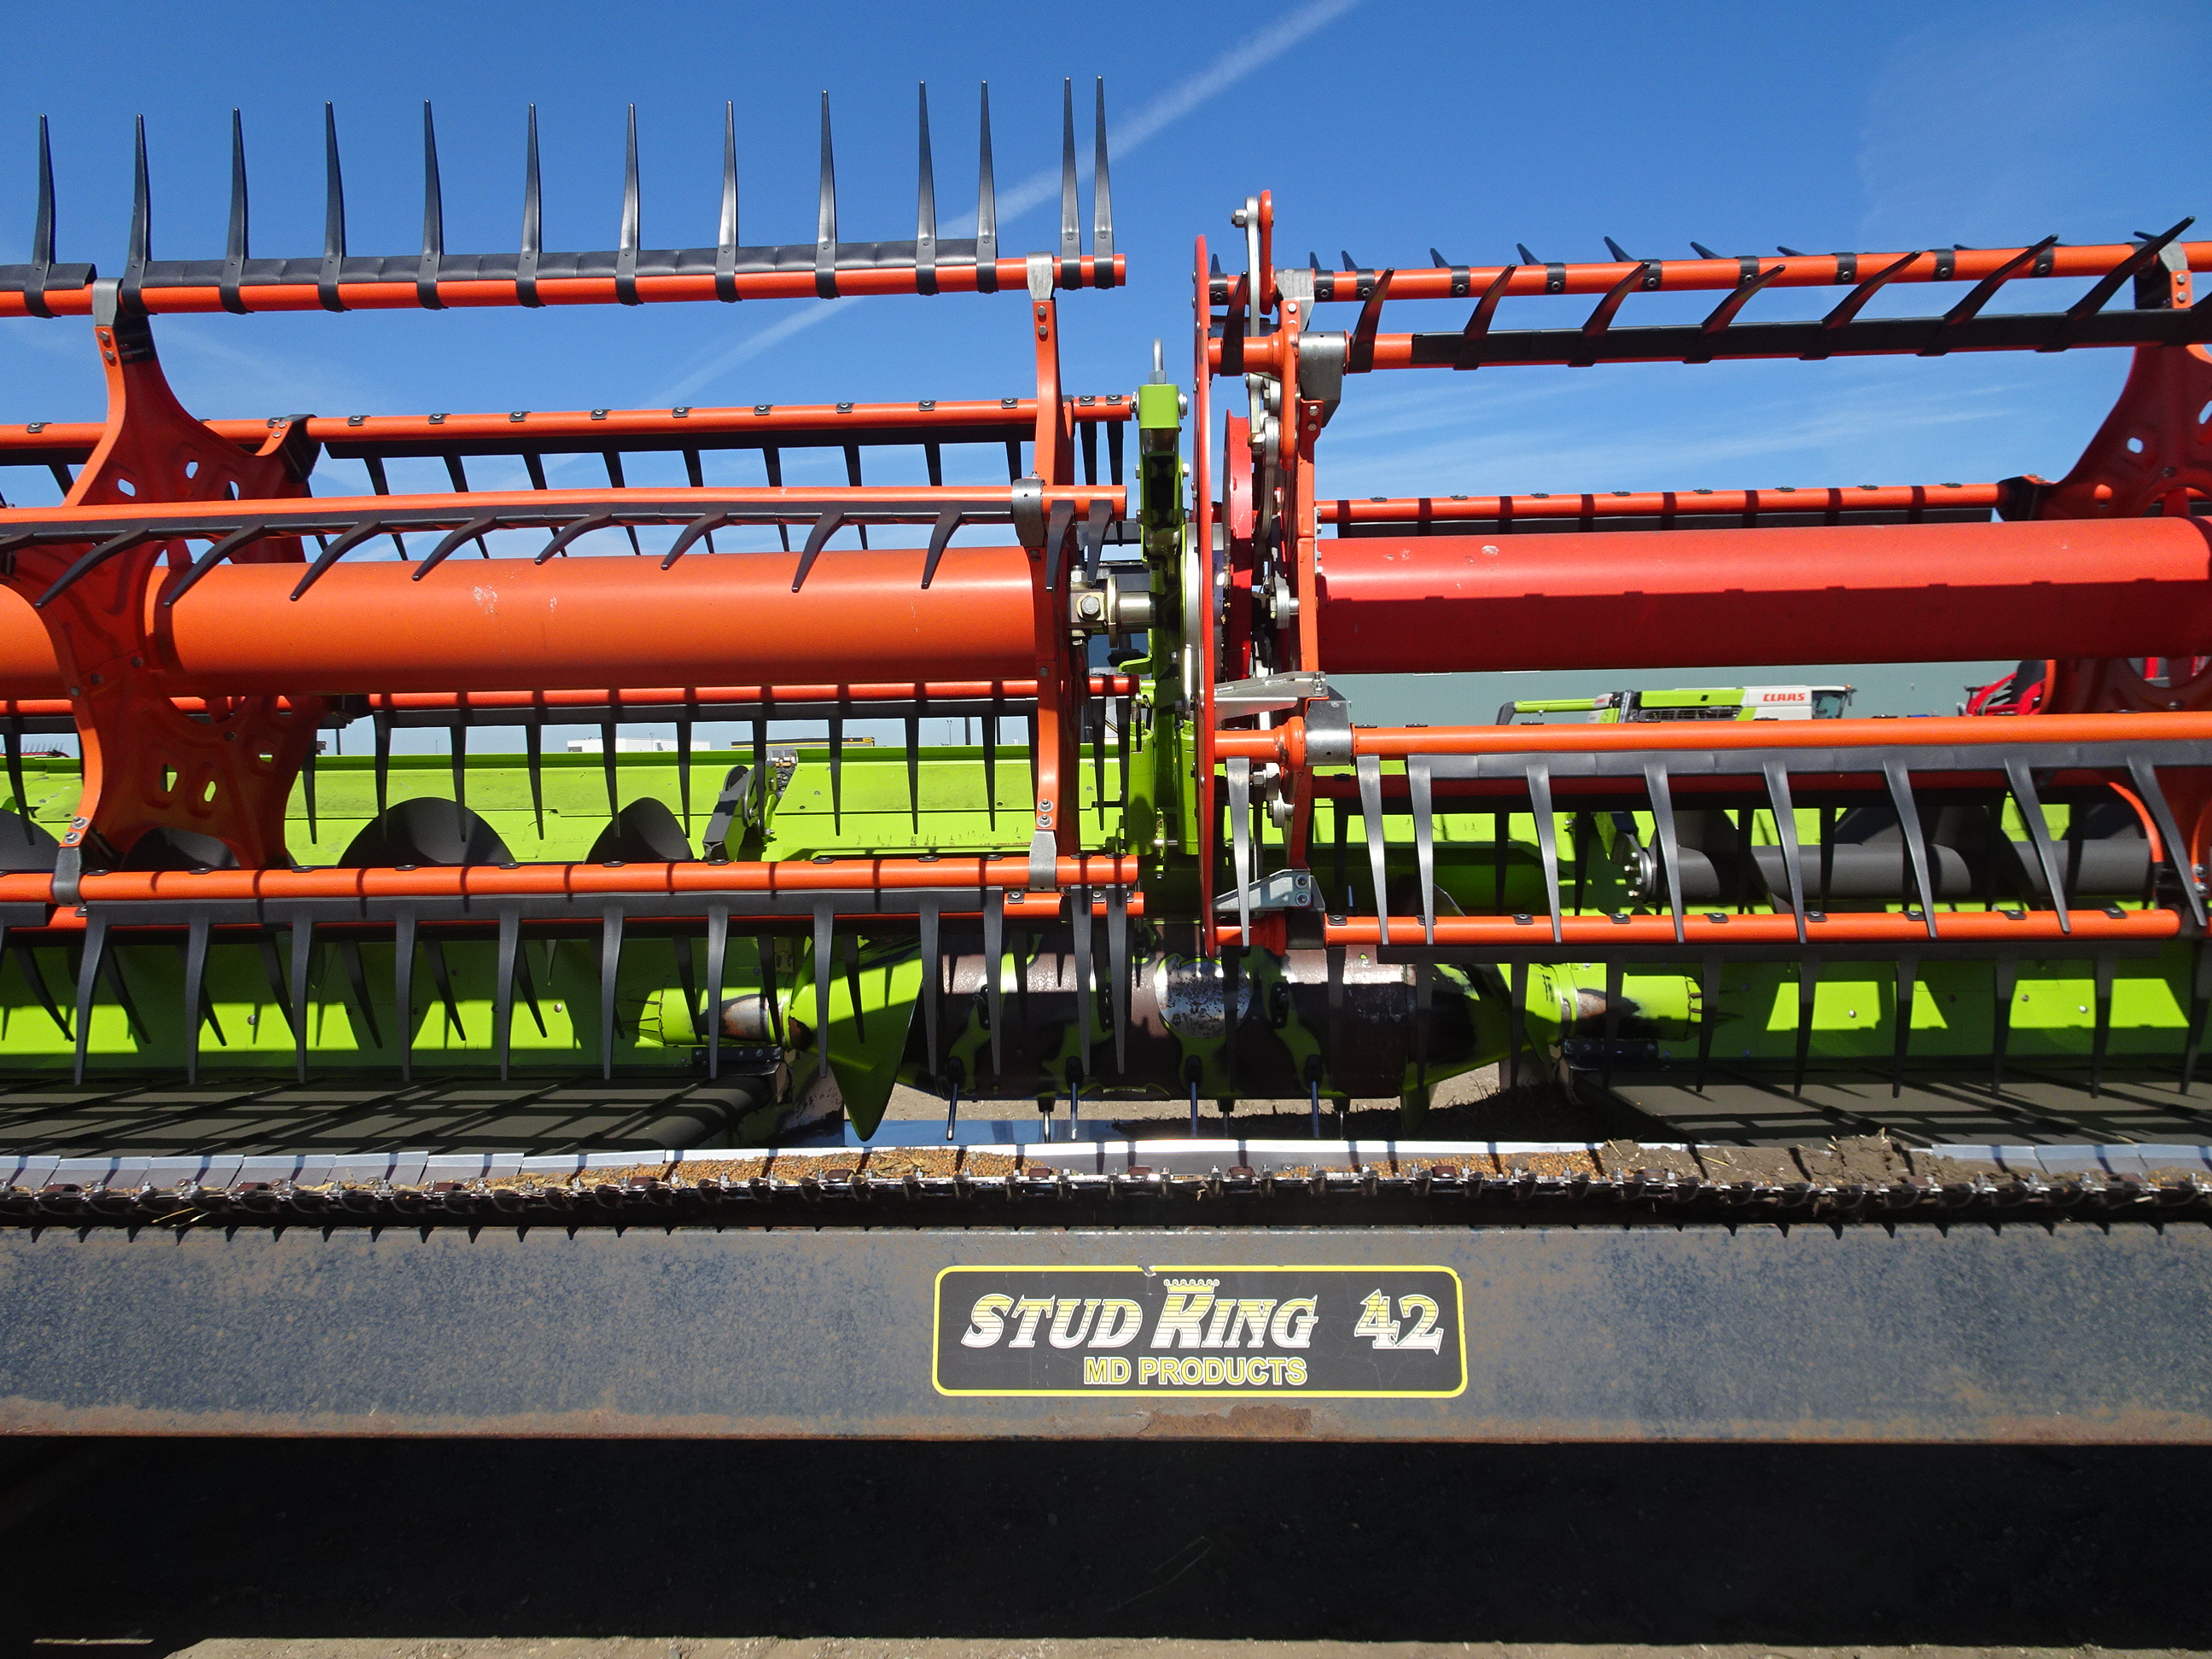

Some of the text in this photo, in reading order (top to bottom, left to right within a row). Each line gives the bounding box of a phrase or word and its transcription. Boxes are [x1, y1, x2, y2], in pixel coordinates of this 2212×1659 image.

[1762, 692, 1806, 702] CLAAS
[961, 1289, 1445, 1354] STUD KING 42
[1084, 1356, 1308, 1386] MD PRODUCTS
